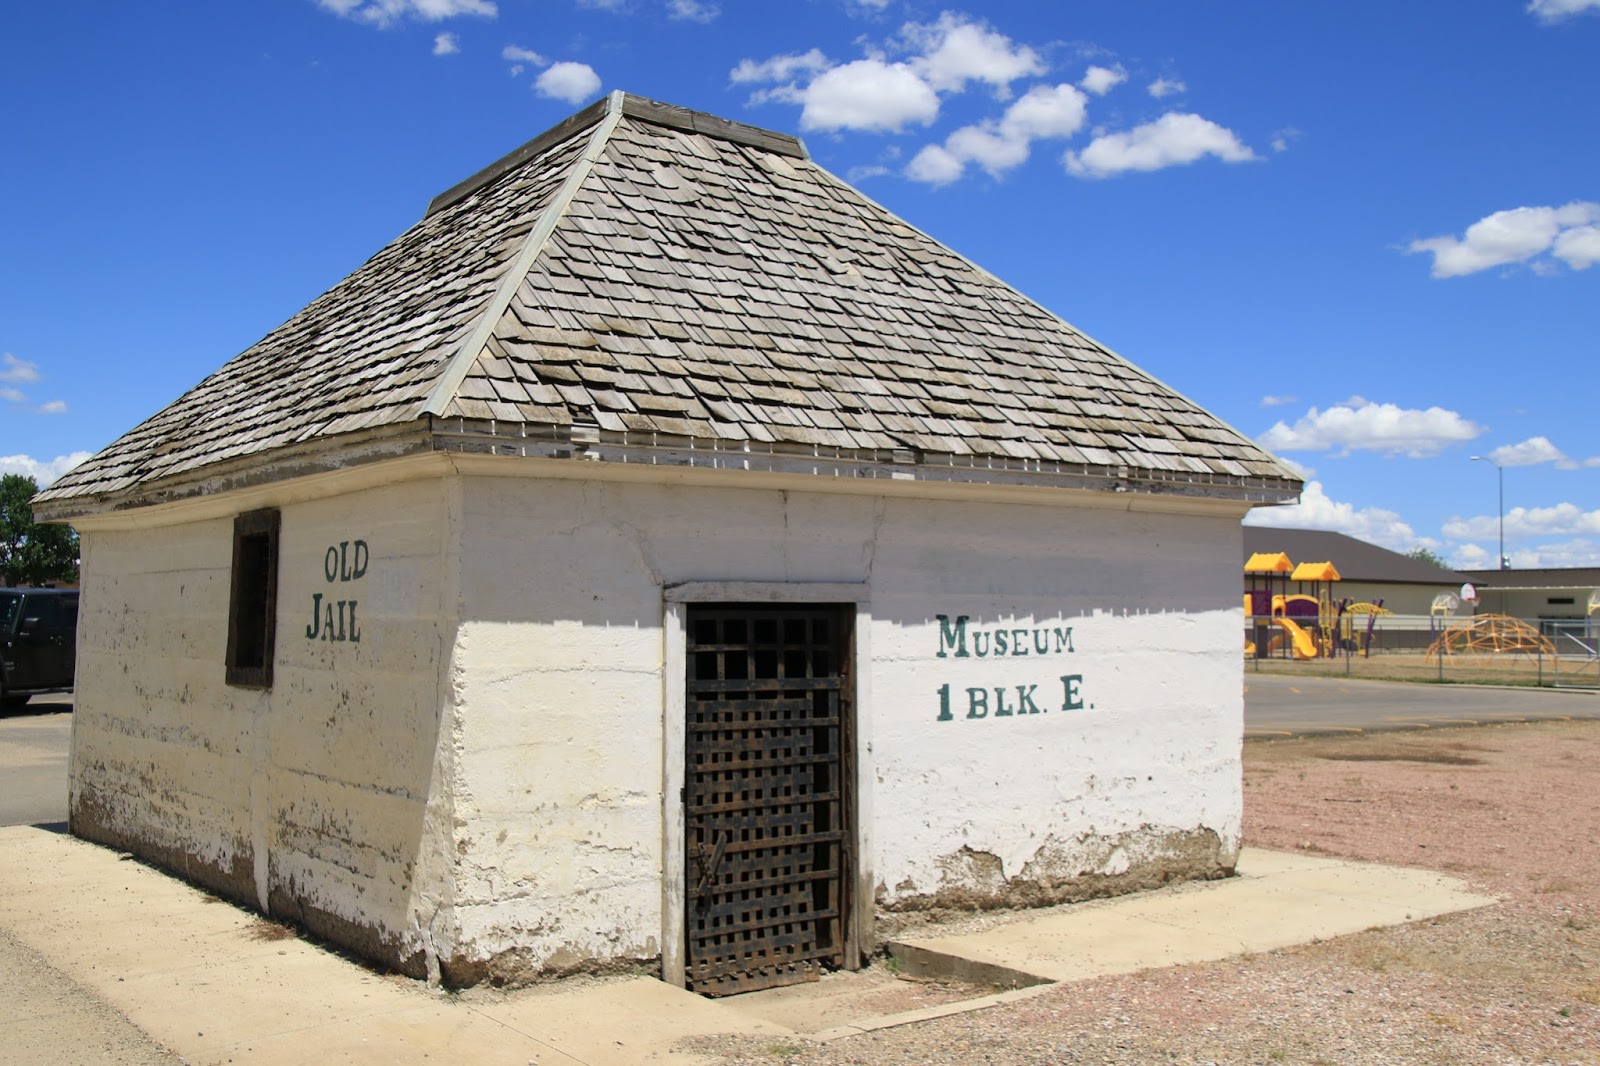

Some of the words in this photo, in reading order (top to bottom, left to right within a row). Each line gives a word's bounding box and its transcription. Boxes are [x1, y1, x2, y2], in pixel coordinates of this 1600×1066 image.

[325, 540, 368, 582] OLD
[306, 593, 361, 642] JAIL
[936, 614, 1075, 658] MUSEUM
[936, 683, 953, 722] 1
[965, 684, 1047, 719] BLK.
[1060, 674, 1094, 711] E.
